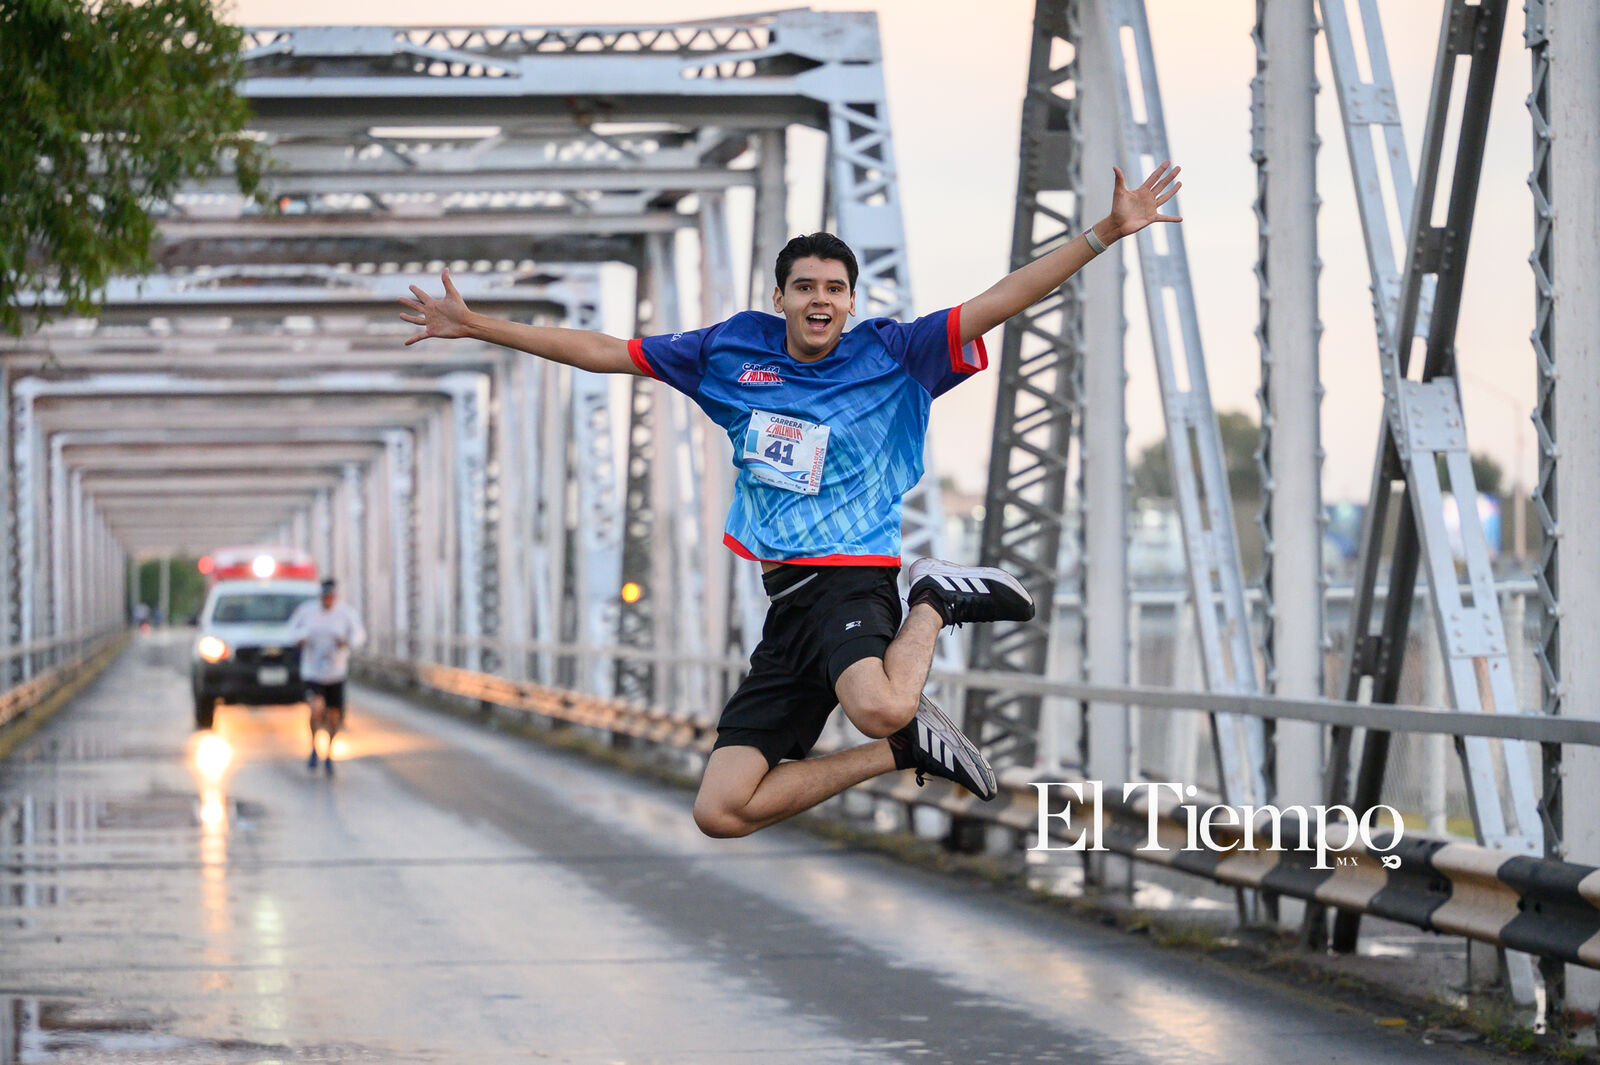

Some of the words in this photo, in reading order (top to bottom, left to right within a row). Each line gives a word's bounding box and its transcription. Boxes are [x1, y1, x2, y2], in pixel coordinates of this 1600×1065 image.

[742, 362, 780, 374] CARRERA
[770, 416, 803, 429] CARRERA
[764, 440, 794, 466] 41
